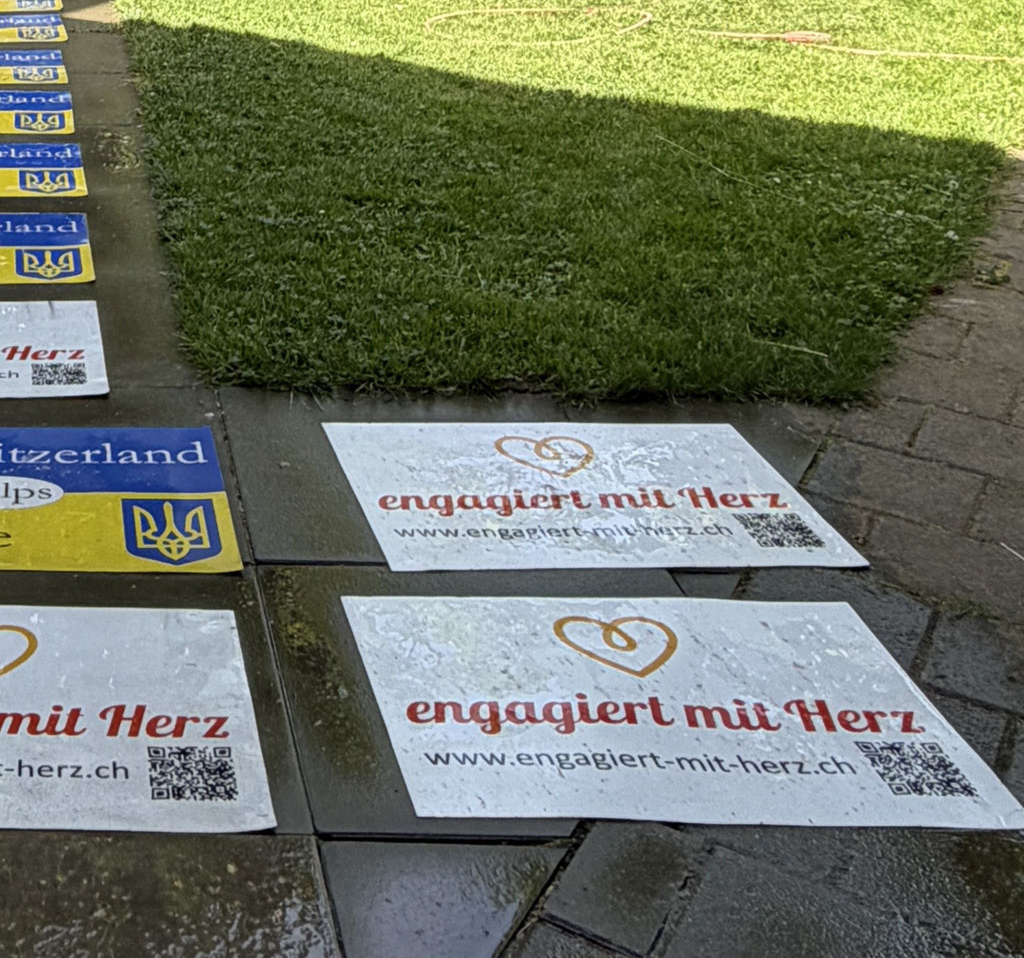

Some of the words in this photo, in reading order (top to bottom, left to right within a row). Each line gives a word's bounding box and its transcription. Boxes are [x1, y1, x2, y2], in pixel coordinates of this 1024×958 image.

[1, 345, 86, 362] Herz
[378, 487, 592, 518] engagiert
[598, 487, 676, 510] mit
[678, 487, 789, 511] Herz
[393, 522, 734, 540] www.engagiert-mit-herz.ch
[98, 704, 230, 739] Herz
[406, 693, 675, 735] engagiert
[684, 698, 782, 732] mit
[784, 699, 925, 735] Herz
[425, 747, 857, 776] www.engagiert-mit-herz.ch
